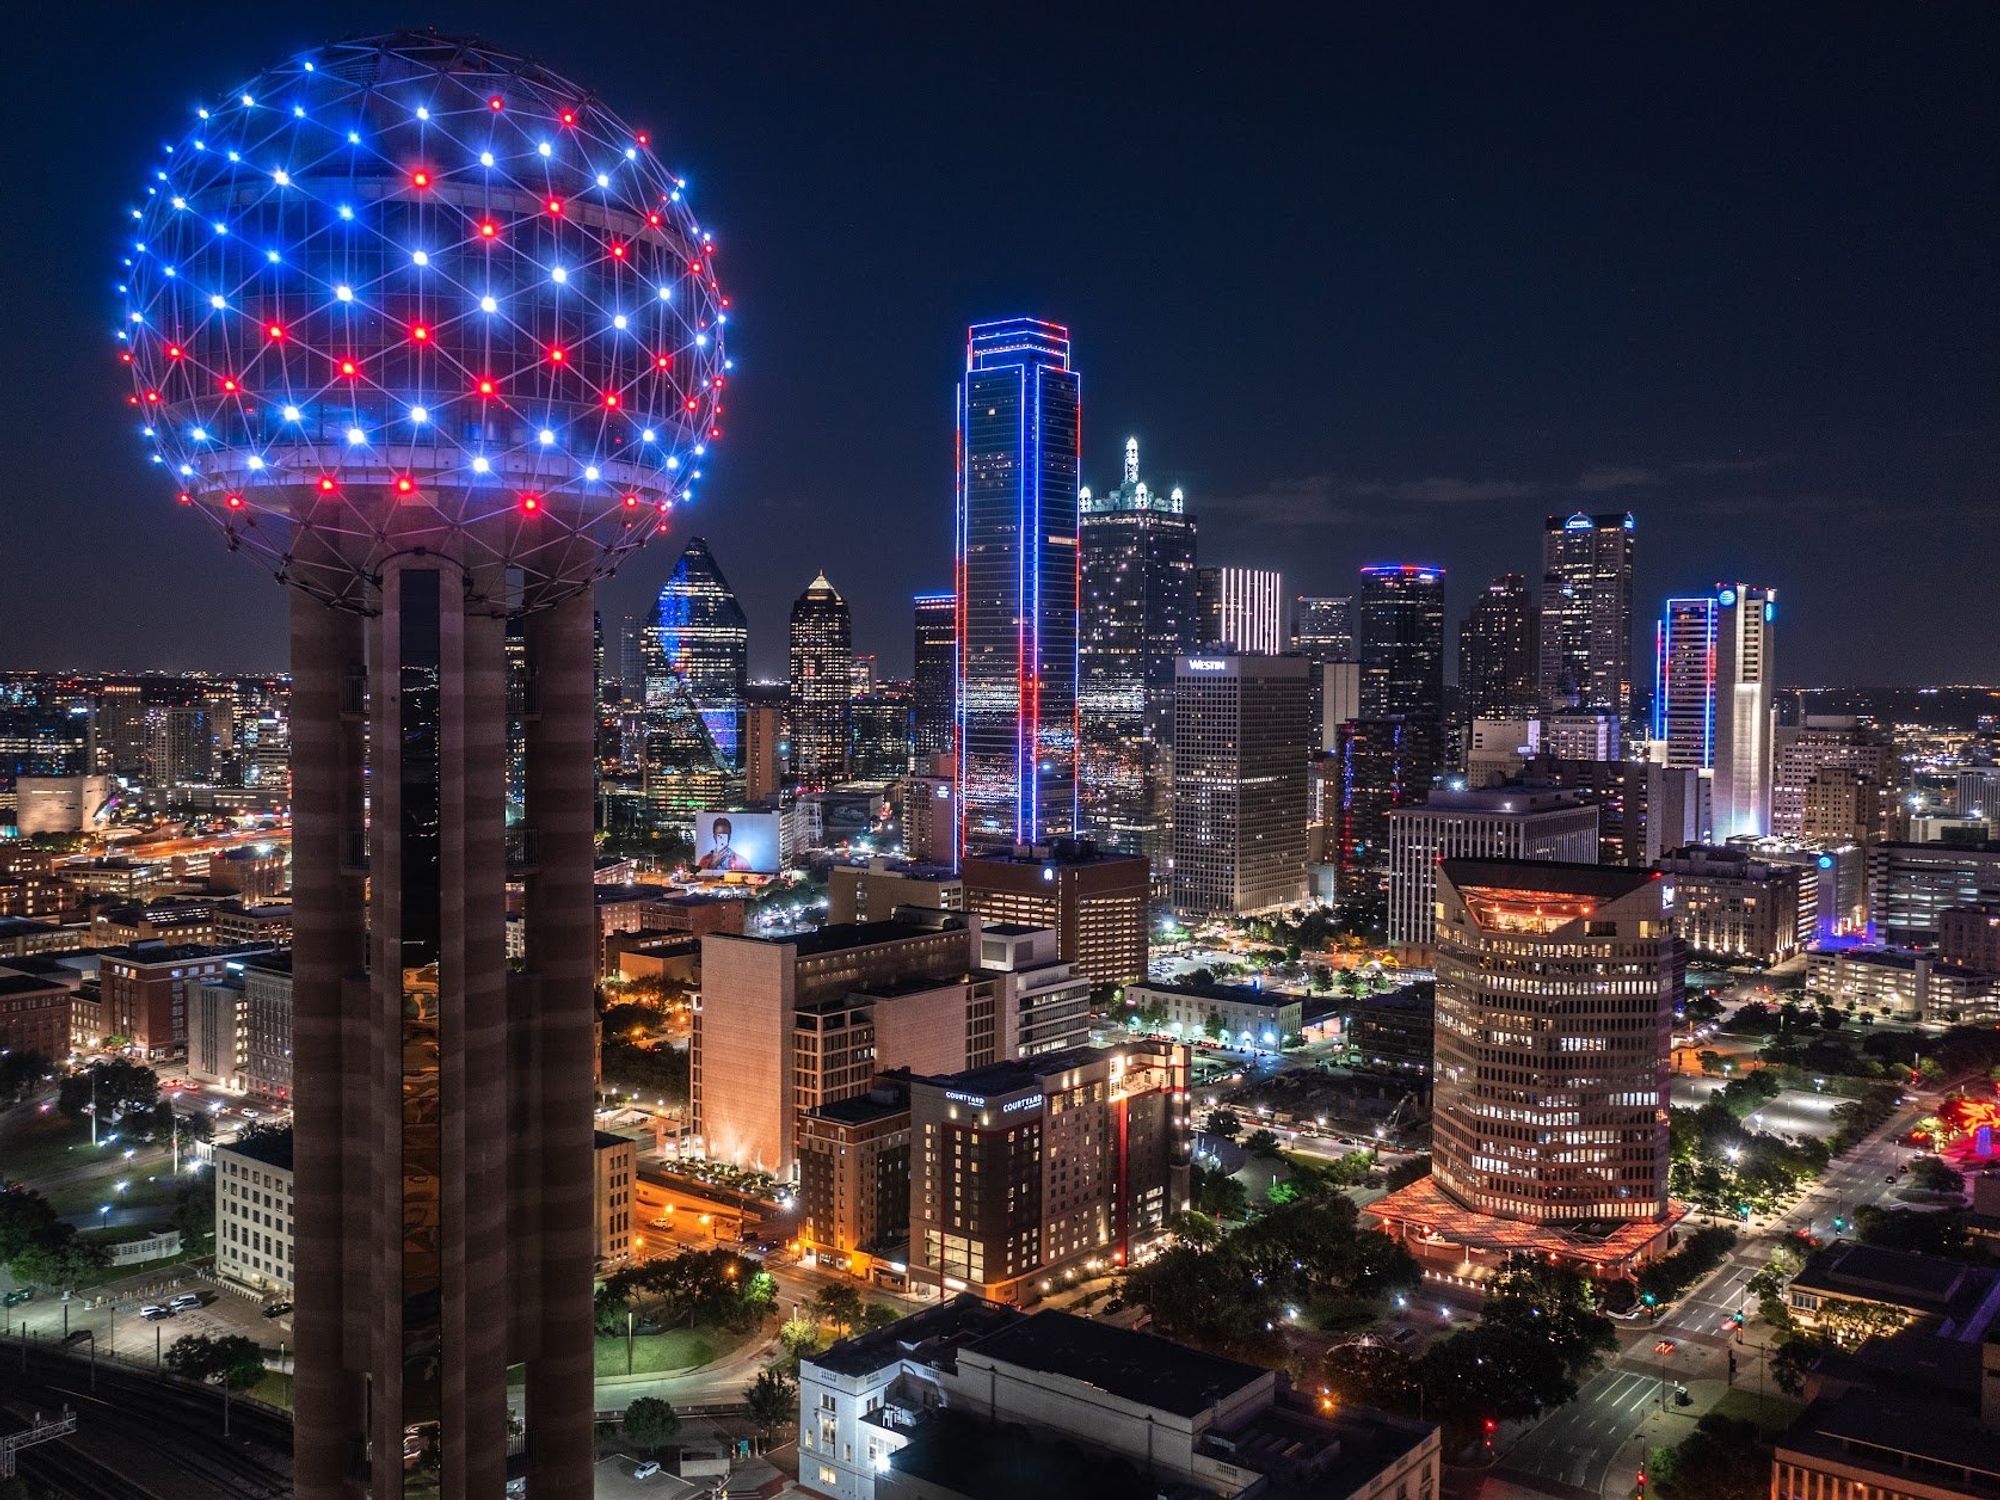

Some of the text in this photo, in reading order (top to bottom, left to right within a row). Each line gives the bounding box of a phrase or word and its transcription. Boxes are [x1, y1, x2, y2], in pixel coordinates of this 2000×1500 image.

[1189, 660, 1225, 670] WESTIN
[946, 1091, 985, 1105] COURTYARD
[1003, 1094, 1043, 1112] COURTYARD
